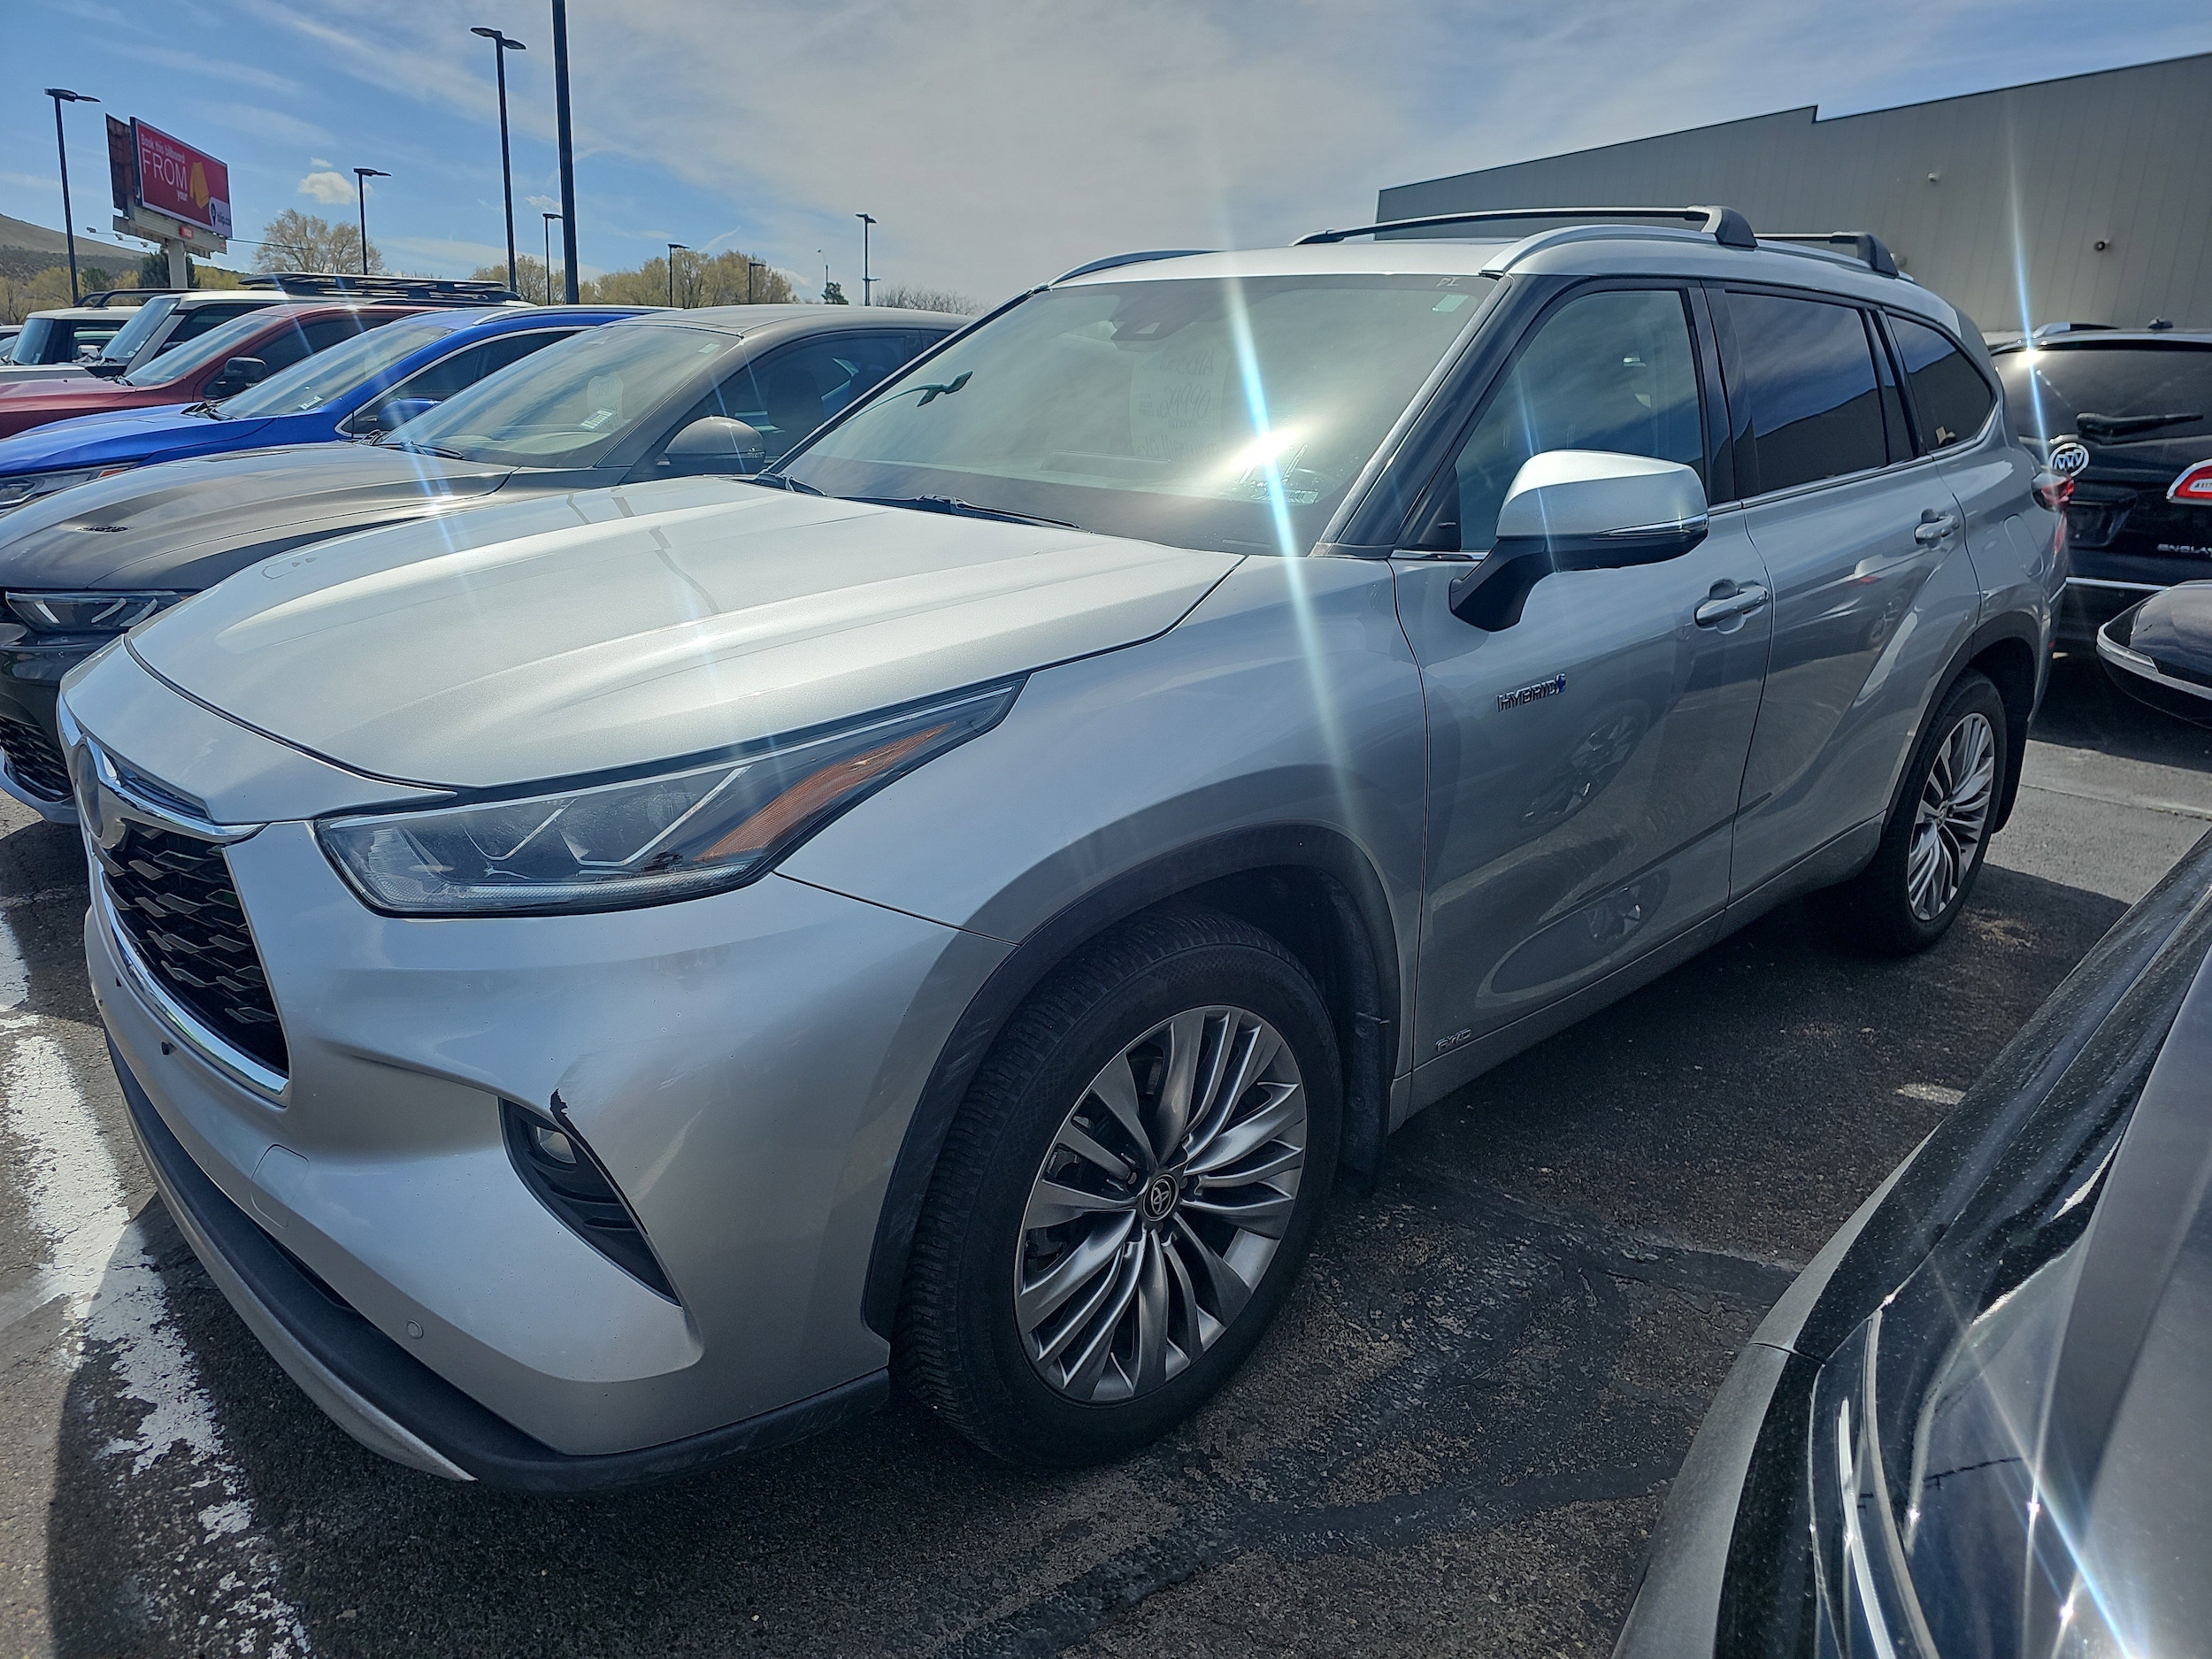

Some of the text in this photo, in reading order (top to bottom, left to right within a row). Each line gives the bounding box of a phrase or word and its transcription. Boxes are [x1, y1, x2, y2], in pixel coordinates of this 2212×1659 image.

[142, 148, 188, 190] FROM
[1496, 679, 1557, 712] HYBRID
[1435, 1028, 1471, 1052] AWD
